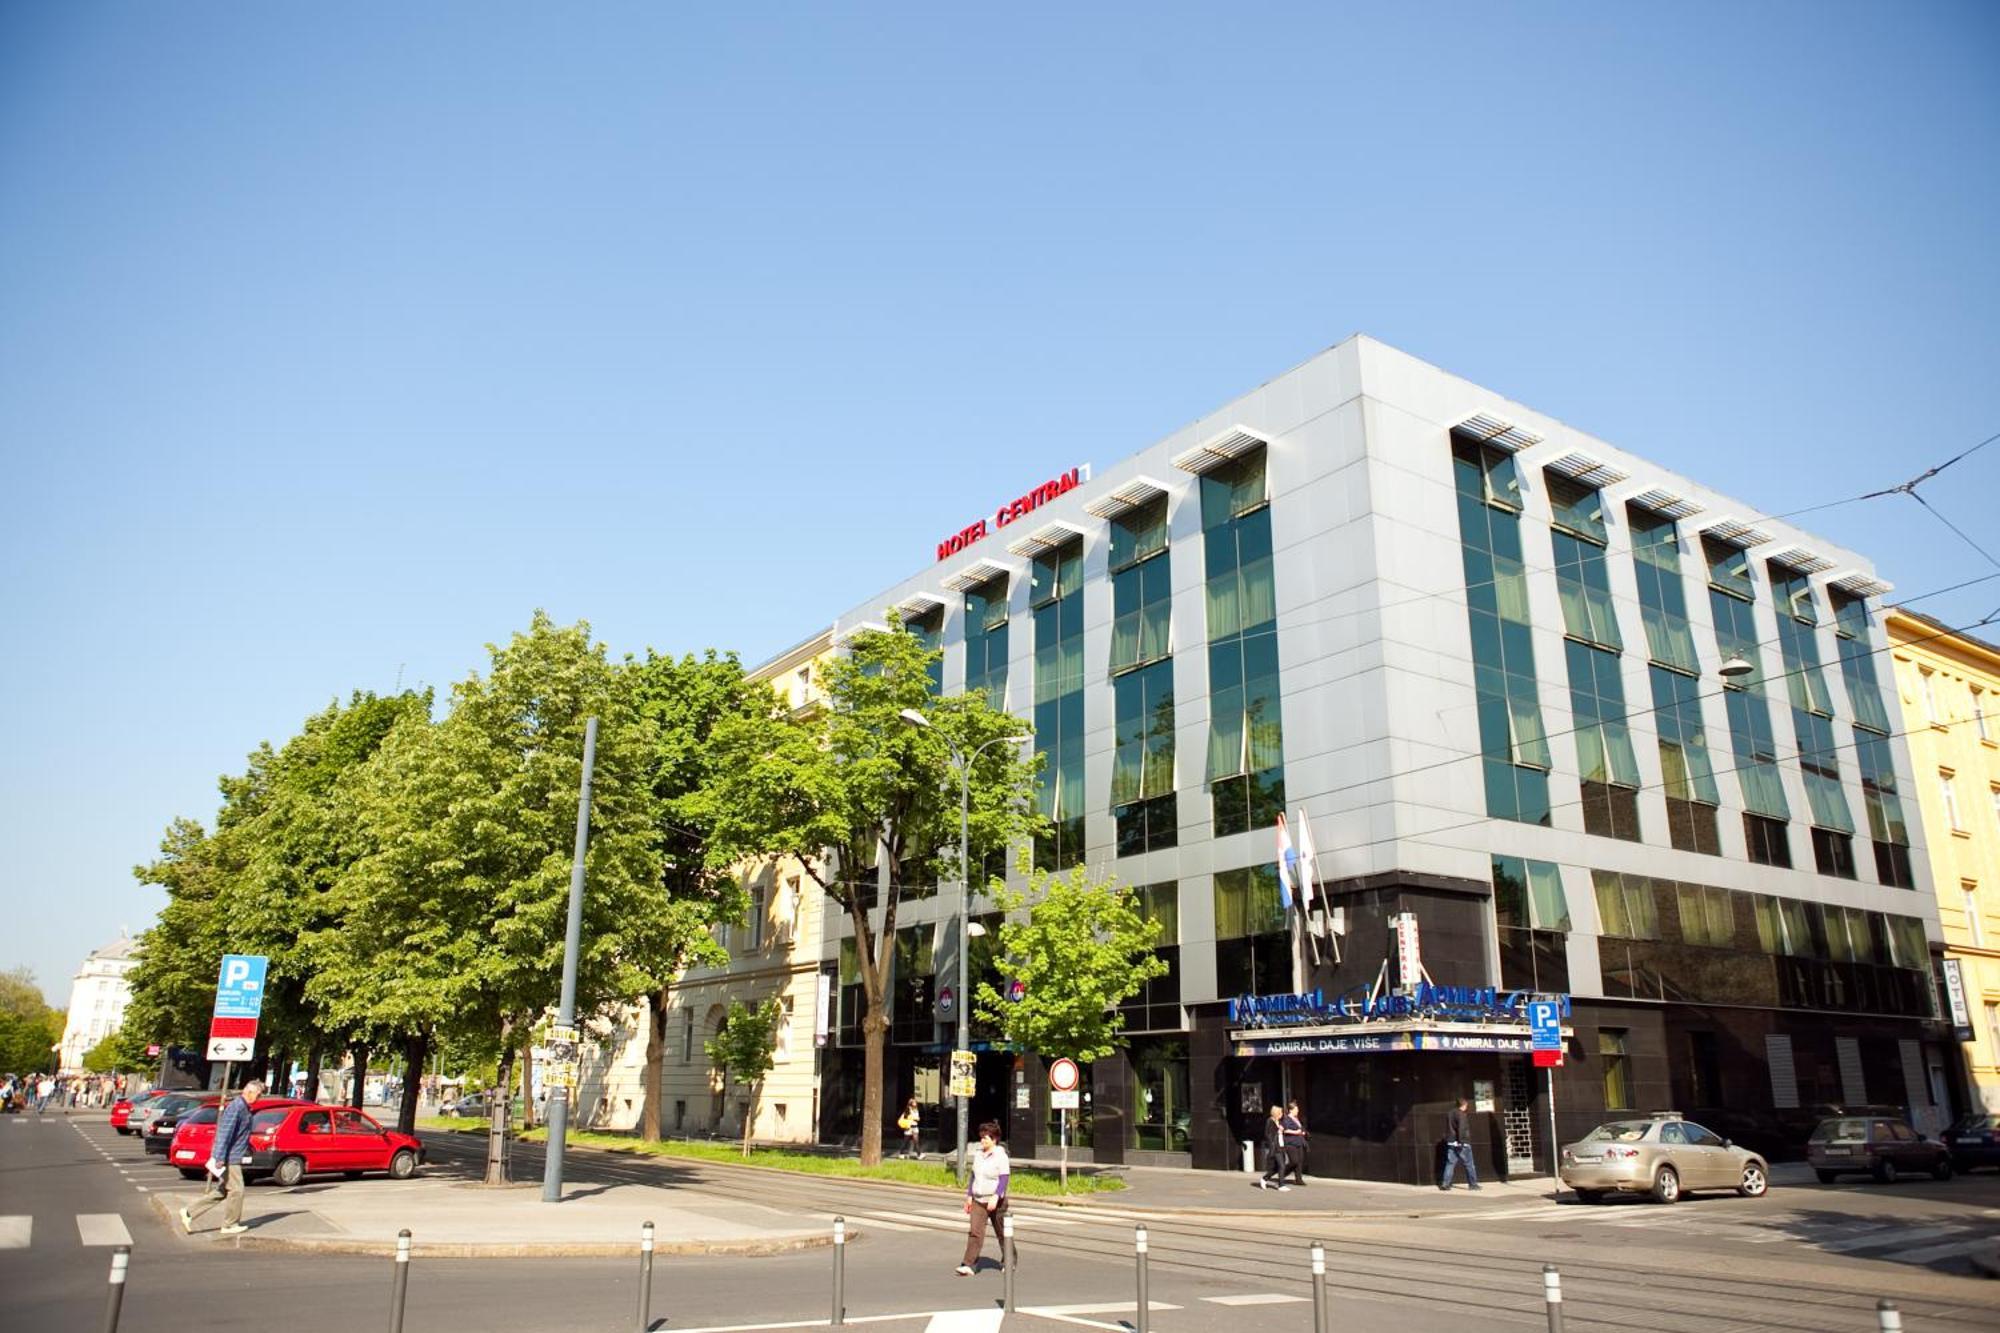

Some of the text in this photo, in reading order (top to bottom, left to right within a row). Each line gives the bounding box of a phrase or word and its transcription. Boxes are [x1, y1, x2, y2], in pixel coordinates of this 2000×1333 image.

[936, 467, 1081, 561] HOTEL CENTRAL
[1399, 922, 1408, 979] CENTRAL
[225, 960, 249, 988] P
[1946, 961, 1967, 1024] HOTEL
[1537, 1005, 1551, 1027] P
[1267, 1042, 1315, 1053] ADMIRAL
[1319, 1039, 1347, 1051] DAJE
[1452, 1037, 1495, 1049] ADMIRAL
[1498, 1038, 1520, 1049] DAJE
